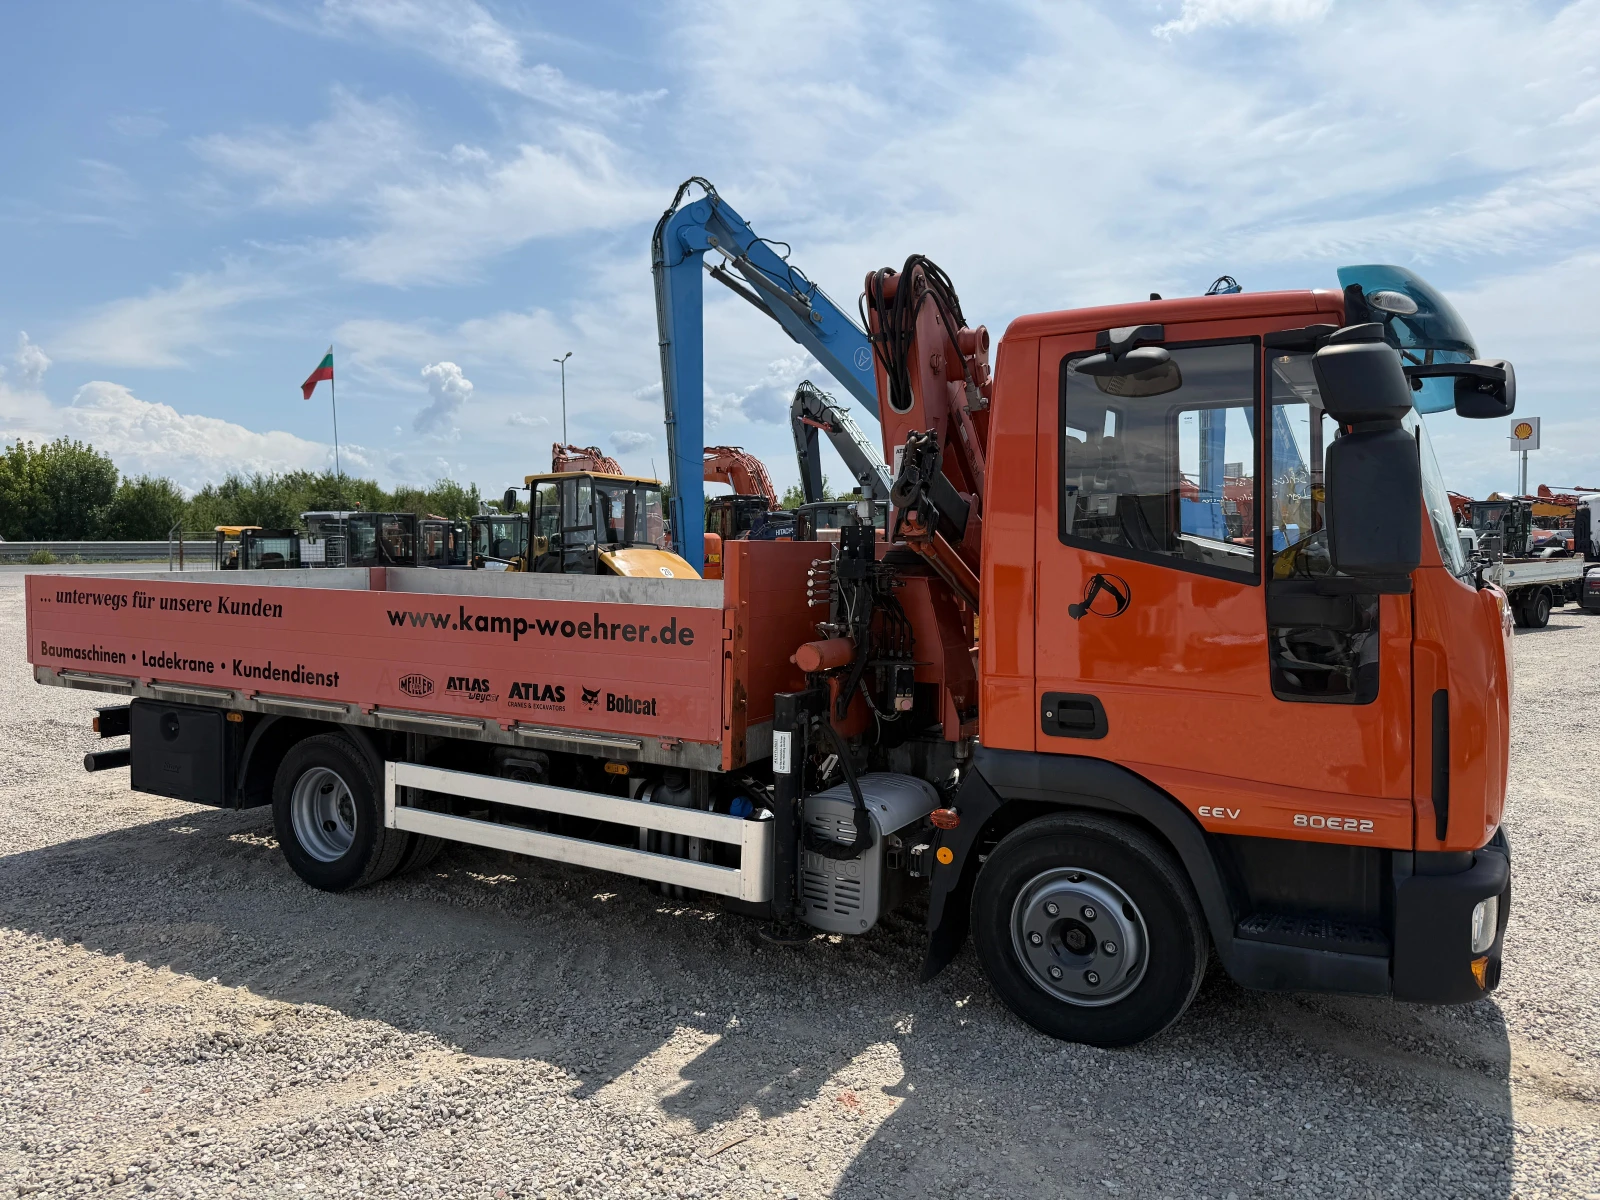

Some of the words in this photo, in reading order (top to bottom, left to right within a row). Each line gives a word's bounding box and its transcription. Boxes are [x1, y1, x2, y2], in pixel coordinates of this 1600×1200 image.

[56, 589, 128, 611] unterwegs
[132, 590, 155, 609] für
[160, 596, 212, 613] unsere
[217, 595, 283, 618] Kunden
[386, 605, 695, 646] www.kamp-woehrer.de
[41, 640, 126, 664] Baumaschinen
[142, 650, 215, 674] Ladekrane
[232, 659, 340, 688] Kundendienst
[400, 675, 433, 695] MEILLER
[446, 676, 490, 693] ATLAS
[508, 681, 566, 703] ATLAS
[507, 700, 527, 709] CRANES
[533, 703, 566, 712] EXCAVATORS
[606, 692, 657, 717] Bobcat
[1198, 805, 1241, 820] EEV
[1293, 813, 1374, 833] 80E22
